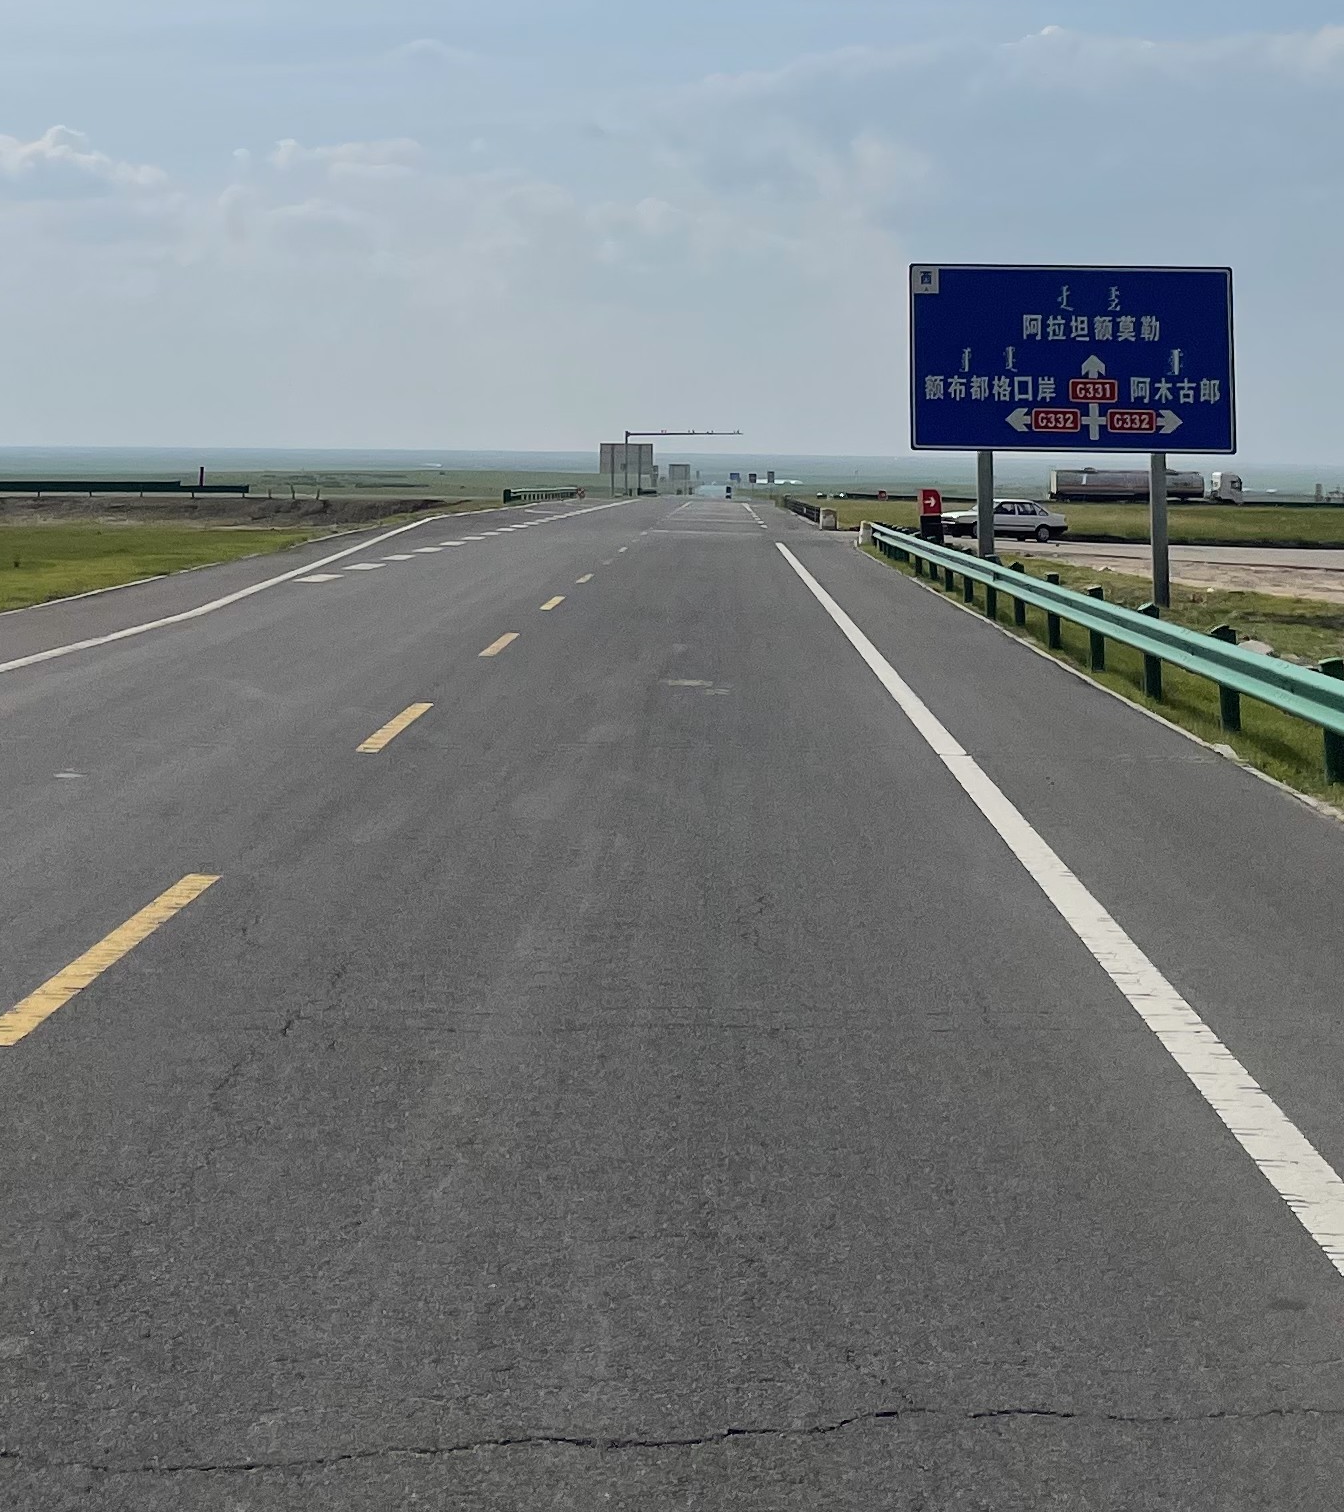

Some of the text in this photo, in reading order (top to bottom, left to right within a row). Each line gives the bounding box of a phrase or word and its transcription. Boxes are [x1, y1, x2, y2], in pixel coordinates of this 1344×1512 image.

[1022, 313, 1161, 342] 阿拉坦额莫勒
[924, 374, 1057, 403] 额布都格口岸
[1076, 383, 1111, 398] G331
[1129, 376, 1222, 405] 阿木古郎
[1038, 413, 1075, 429] G332
[1113, 414, 1151, 429] G332
